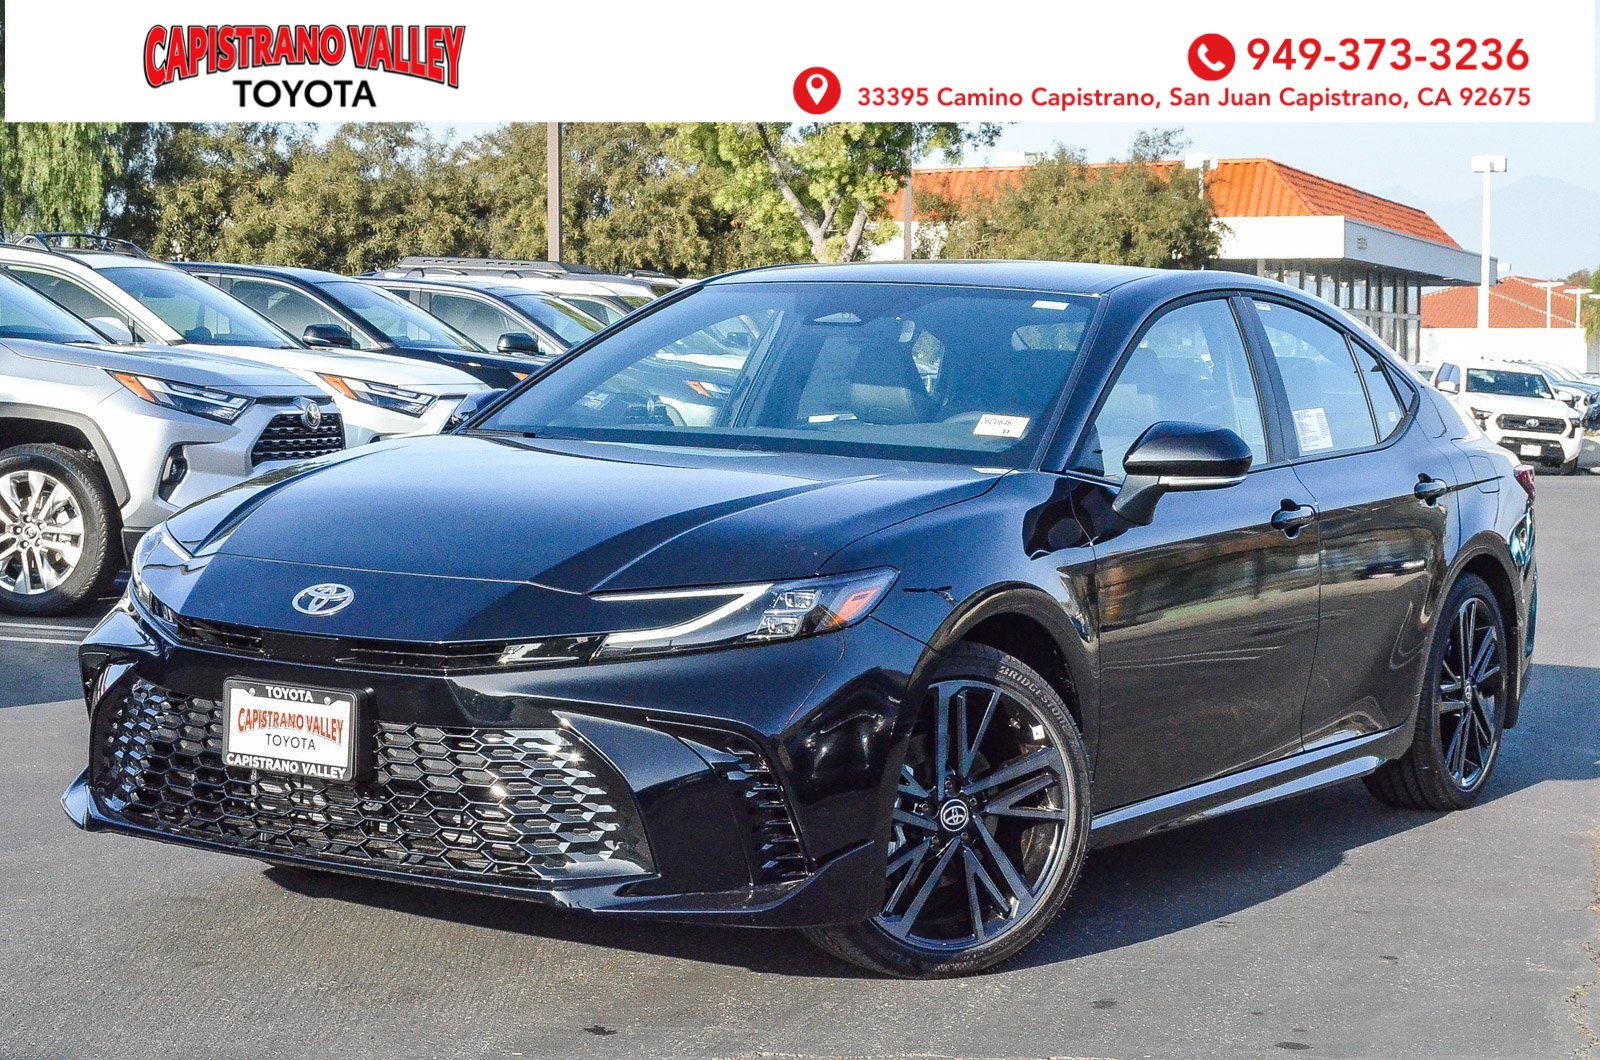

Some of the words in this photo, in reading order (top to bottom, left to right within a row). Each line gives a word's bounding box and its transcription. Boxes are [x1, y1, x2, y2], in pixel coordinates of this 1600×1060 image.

[265, 686, 314, 703] TOYOTA
[998, 665, 1069, 732] BRIDGESTONE
[238, 707, 304, 733] CAPISTRANO
[305, 715, 344, 746] VALLEY
[266, 733, 316, 751] TOYOTA
[226, 753, 299, 773] CAPISTRANO
[302, 763, 347, 780] VALLEY
